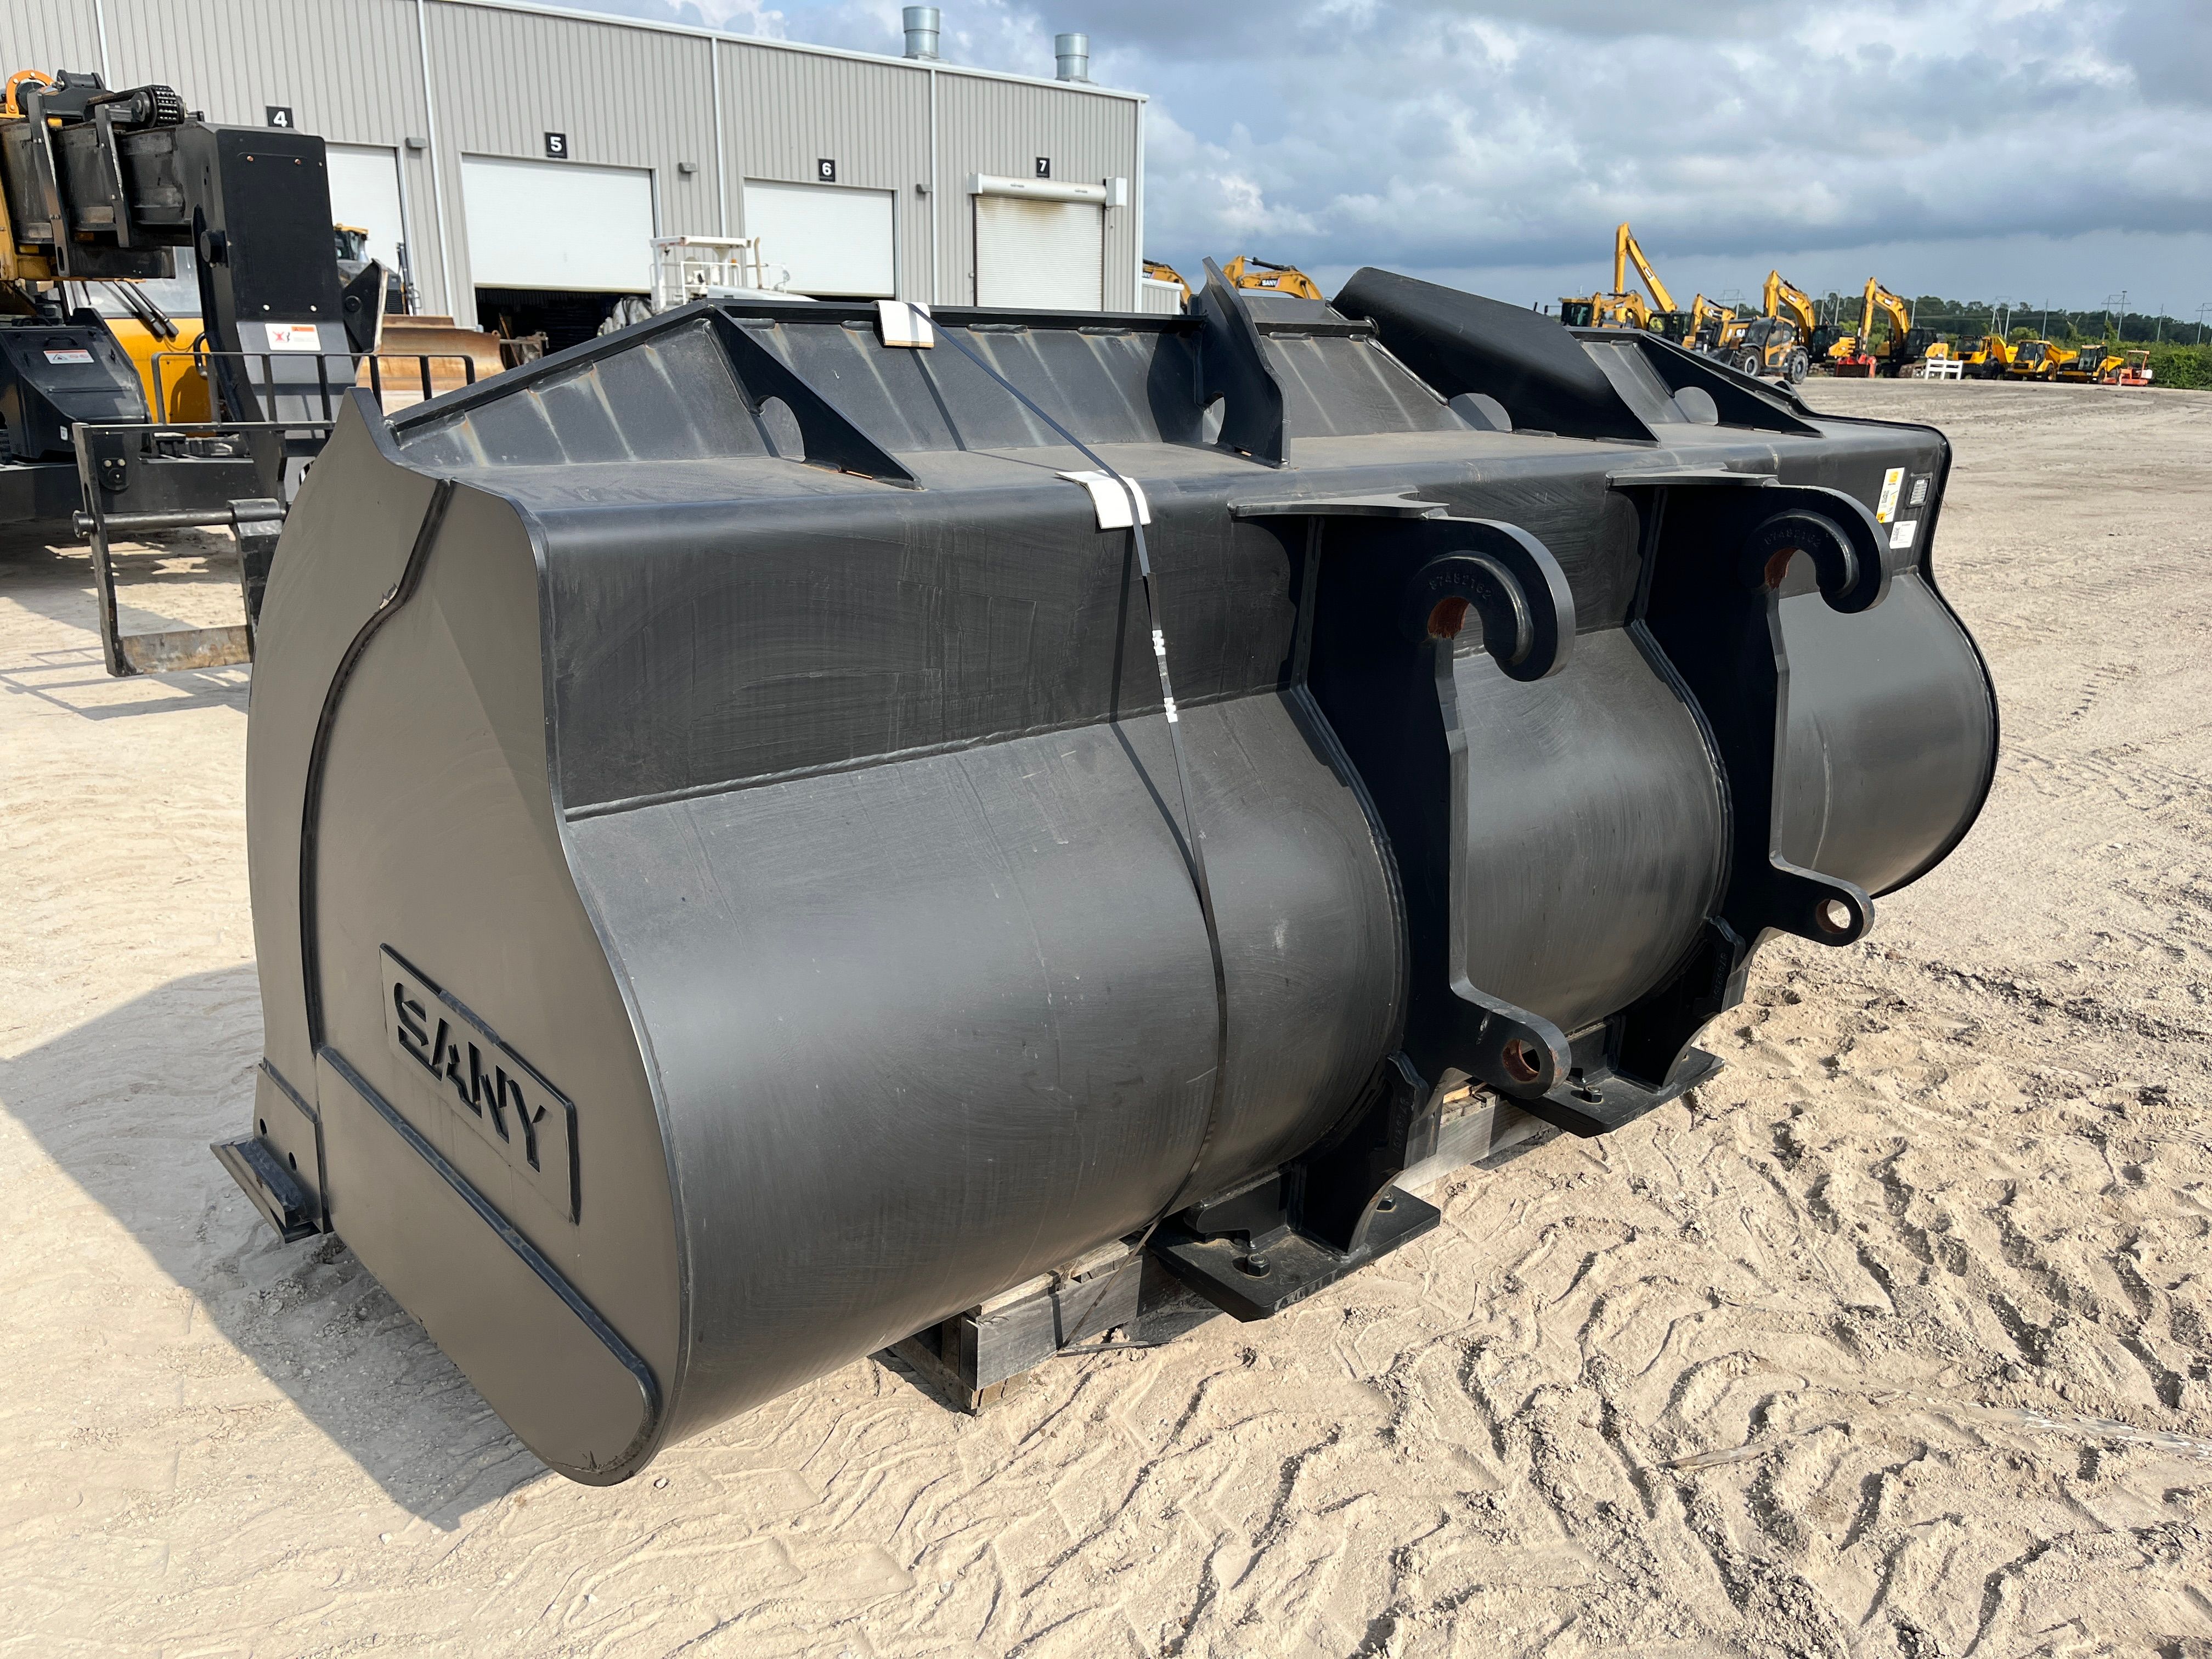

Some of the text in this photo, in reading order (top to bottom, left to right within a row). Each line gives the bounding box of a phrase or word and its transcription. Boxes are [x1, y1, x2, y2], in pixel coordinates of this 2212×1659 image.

[273, 111, 287, 127] 4
[550, 137, 562, 152] 5
[822, 162, 832, 176] 6
[1039, 160, 1047, 172] 7
[393, 981, 554, 1173] SANY
